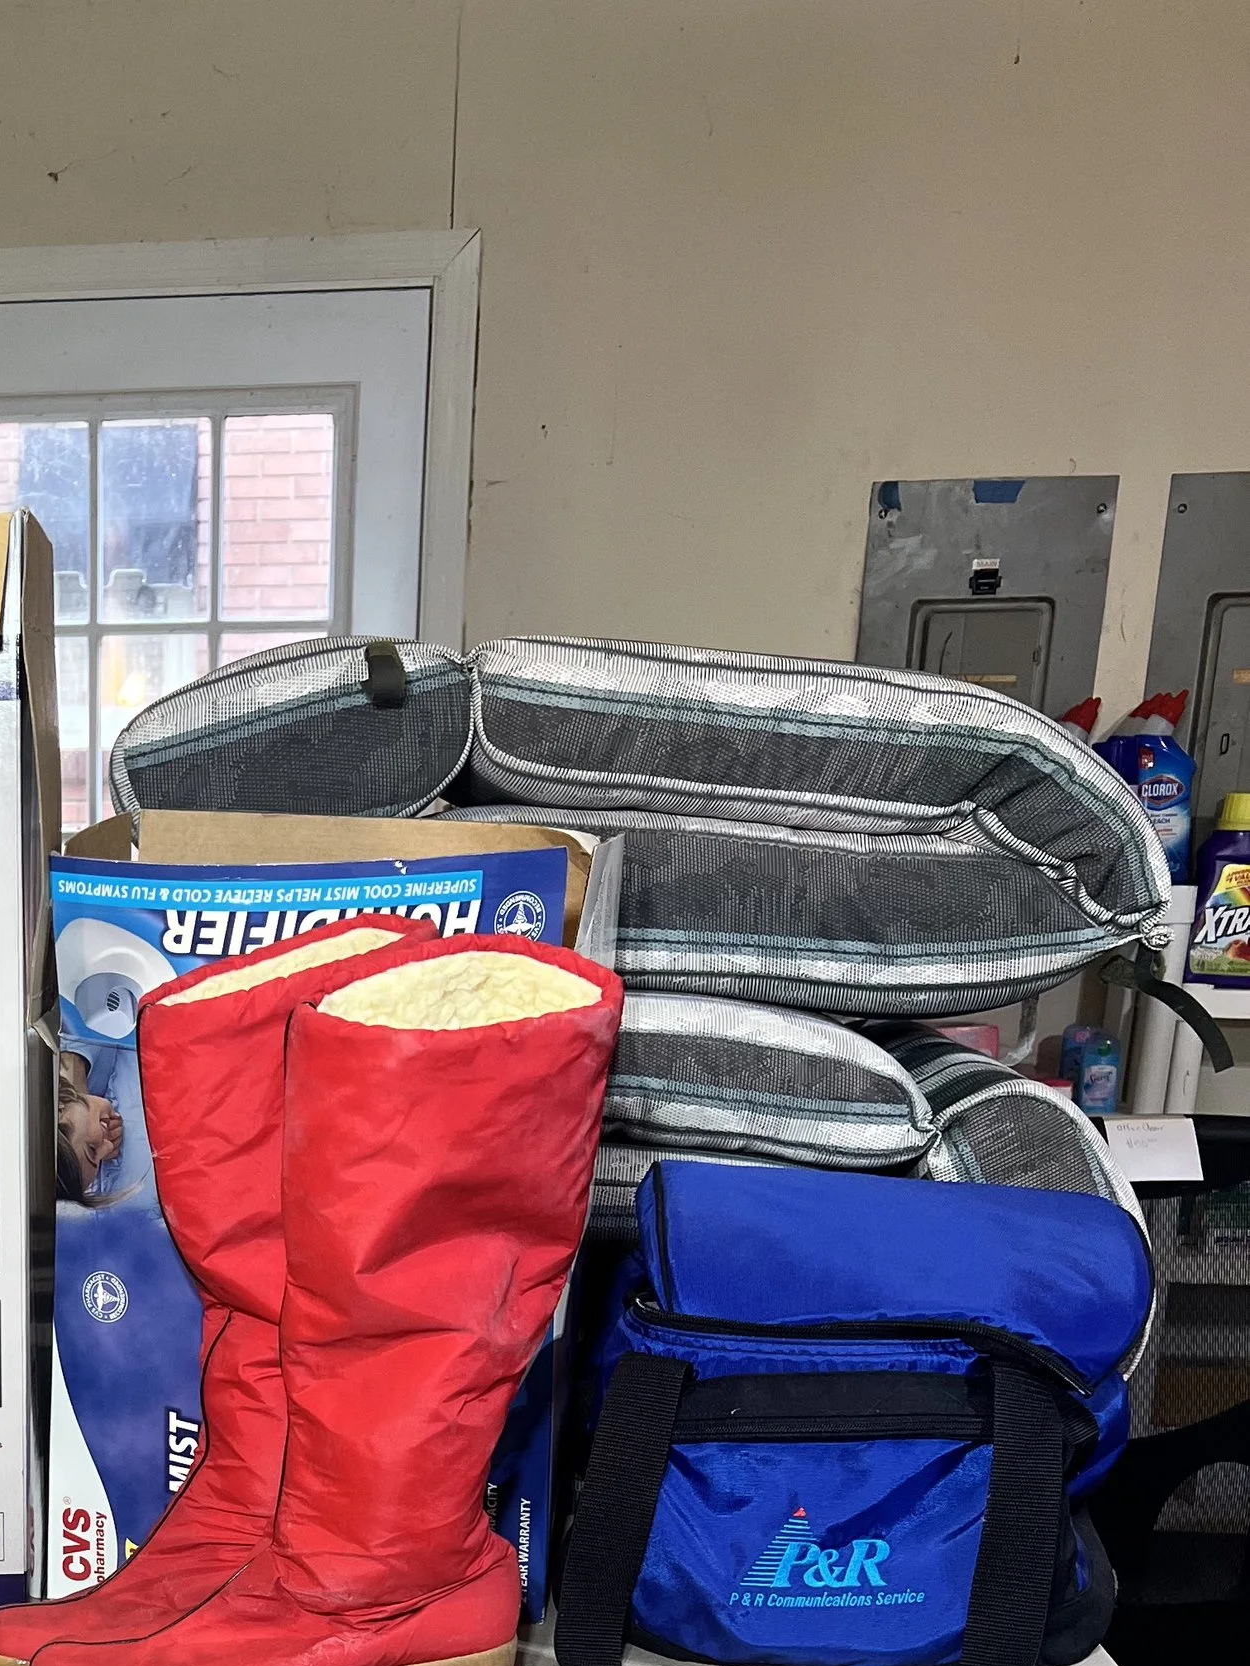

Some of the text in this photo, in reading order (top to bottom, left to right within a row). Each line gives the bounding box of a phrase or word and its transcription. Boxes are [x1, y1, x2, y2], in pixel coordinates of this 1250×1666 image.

[1141, 783, 1179, 797] CLOROX
[58, 878, 478, 905] SUPERFINE COOL MIST HELPS RELIEVE COLD & FLU SYMPTOMS
[168, 1411, 199, 1492] MIST
[487, 1482, 498, 1531] APACITY
[62, 1507, 92, 1581] CVS
[94, 1511, 107, 1583] pharmacy
[518, 1497, 531, 1592] EAR WARRANTY
[771, 1539, 890, 1588] P&R
[729, 1588, 925, 1608] P & R Communications Service
